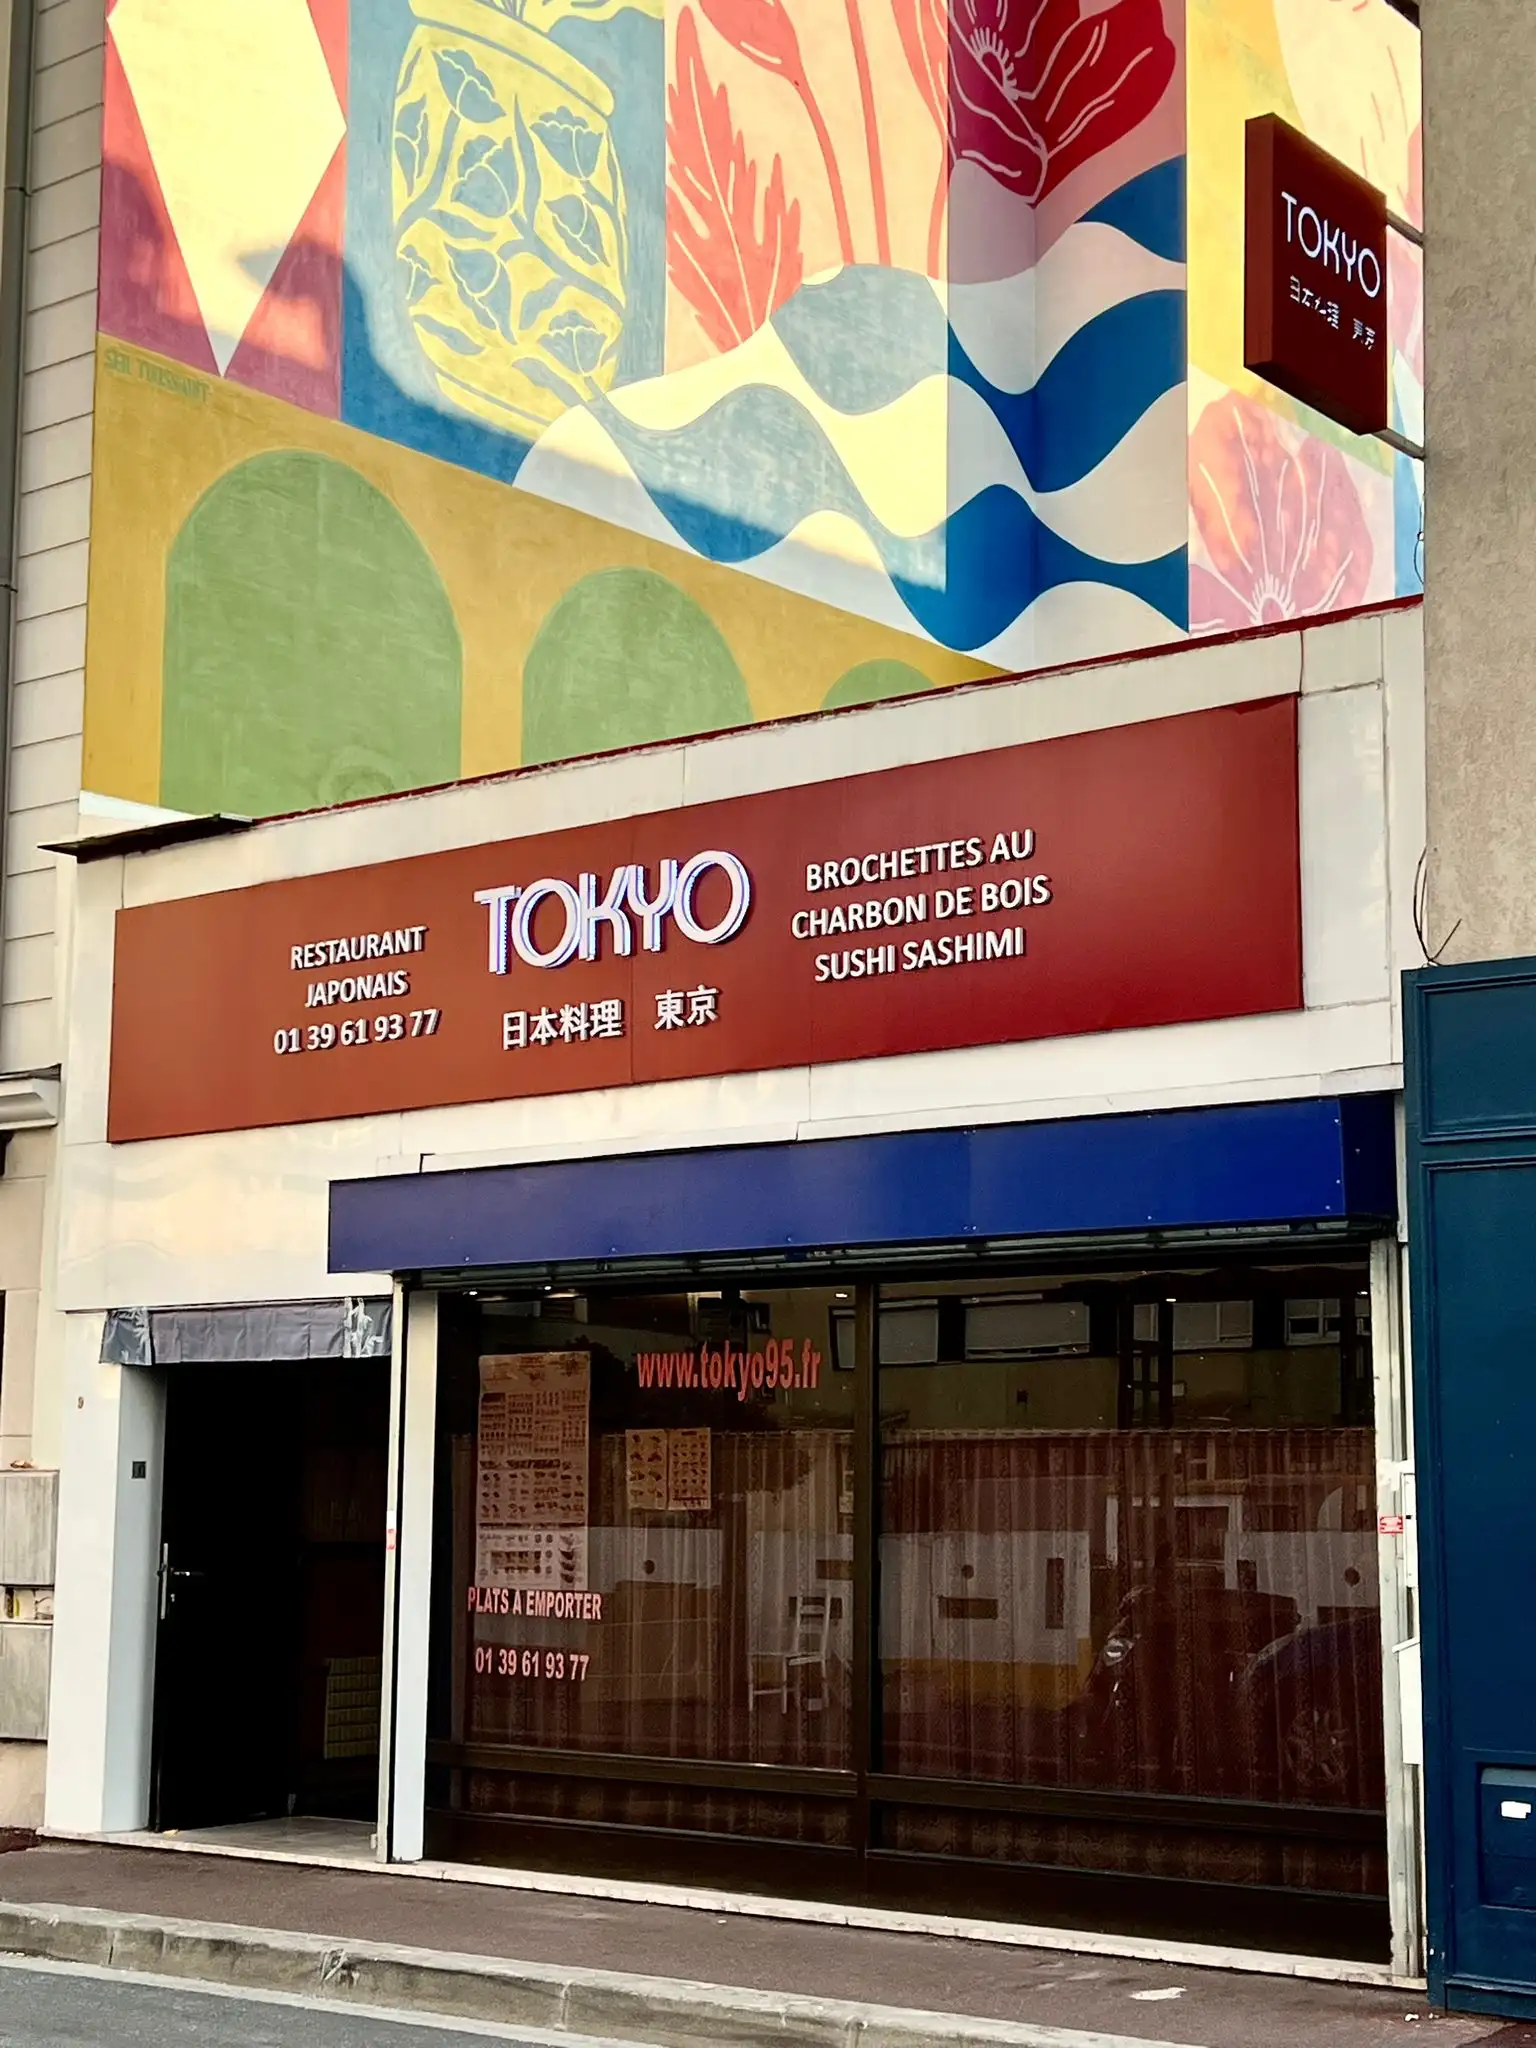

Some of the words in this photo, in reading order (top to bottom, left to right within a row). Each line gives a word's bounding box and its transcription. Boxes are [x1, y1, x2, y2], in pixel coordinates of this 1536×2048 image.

[1281, 190, 1381, 299] TOKYO
[806, 836, 984, 893] BROCHETTES
[988, 828, 1036, 864] AU
[473, 850, 751, 975] TOKYO
[791, 893, 929, 940] CHARBON
[935, 886, 975, 920] DE
[981, 874, 1052, 913] BOIS
[290, 925, 429, 971] RESTAURANT
[814, 944, 897, 983] SUSHI
[902, 926, 1027, 972] SASHIMI
[304, 970, 410, 1009] JAPONAIS
[503, 998, 624, 1050] 日本料理
[654, 984, 721, 1031] 東京
[273, 1027, 302, 1055] 01
[306, 1023, 336, 1051] 39
[340, 1018, 370, 1046] 61
[374, 1013, 404, 1042] 93
[409, 1008, 440, 1038] 77
[636, 1337, 822, 1402] www.tokyo95.fr
[467, 1586, 510, 1615] PLATS
[512, 1590, 522, 1615] A
[526, 1590, 602, 1620] EMPORTER
[475, 1646, 493, 1675] 01
[498, 1648, 518, 1676] 39
[521, 1650, 540, 1678] 61
[545, 1651, 565, 1679] 93
[569, 1654, 590, 1682] 77
